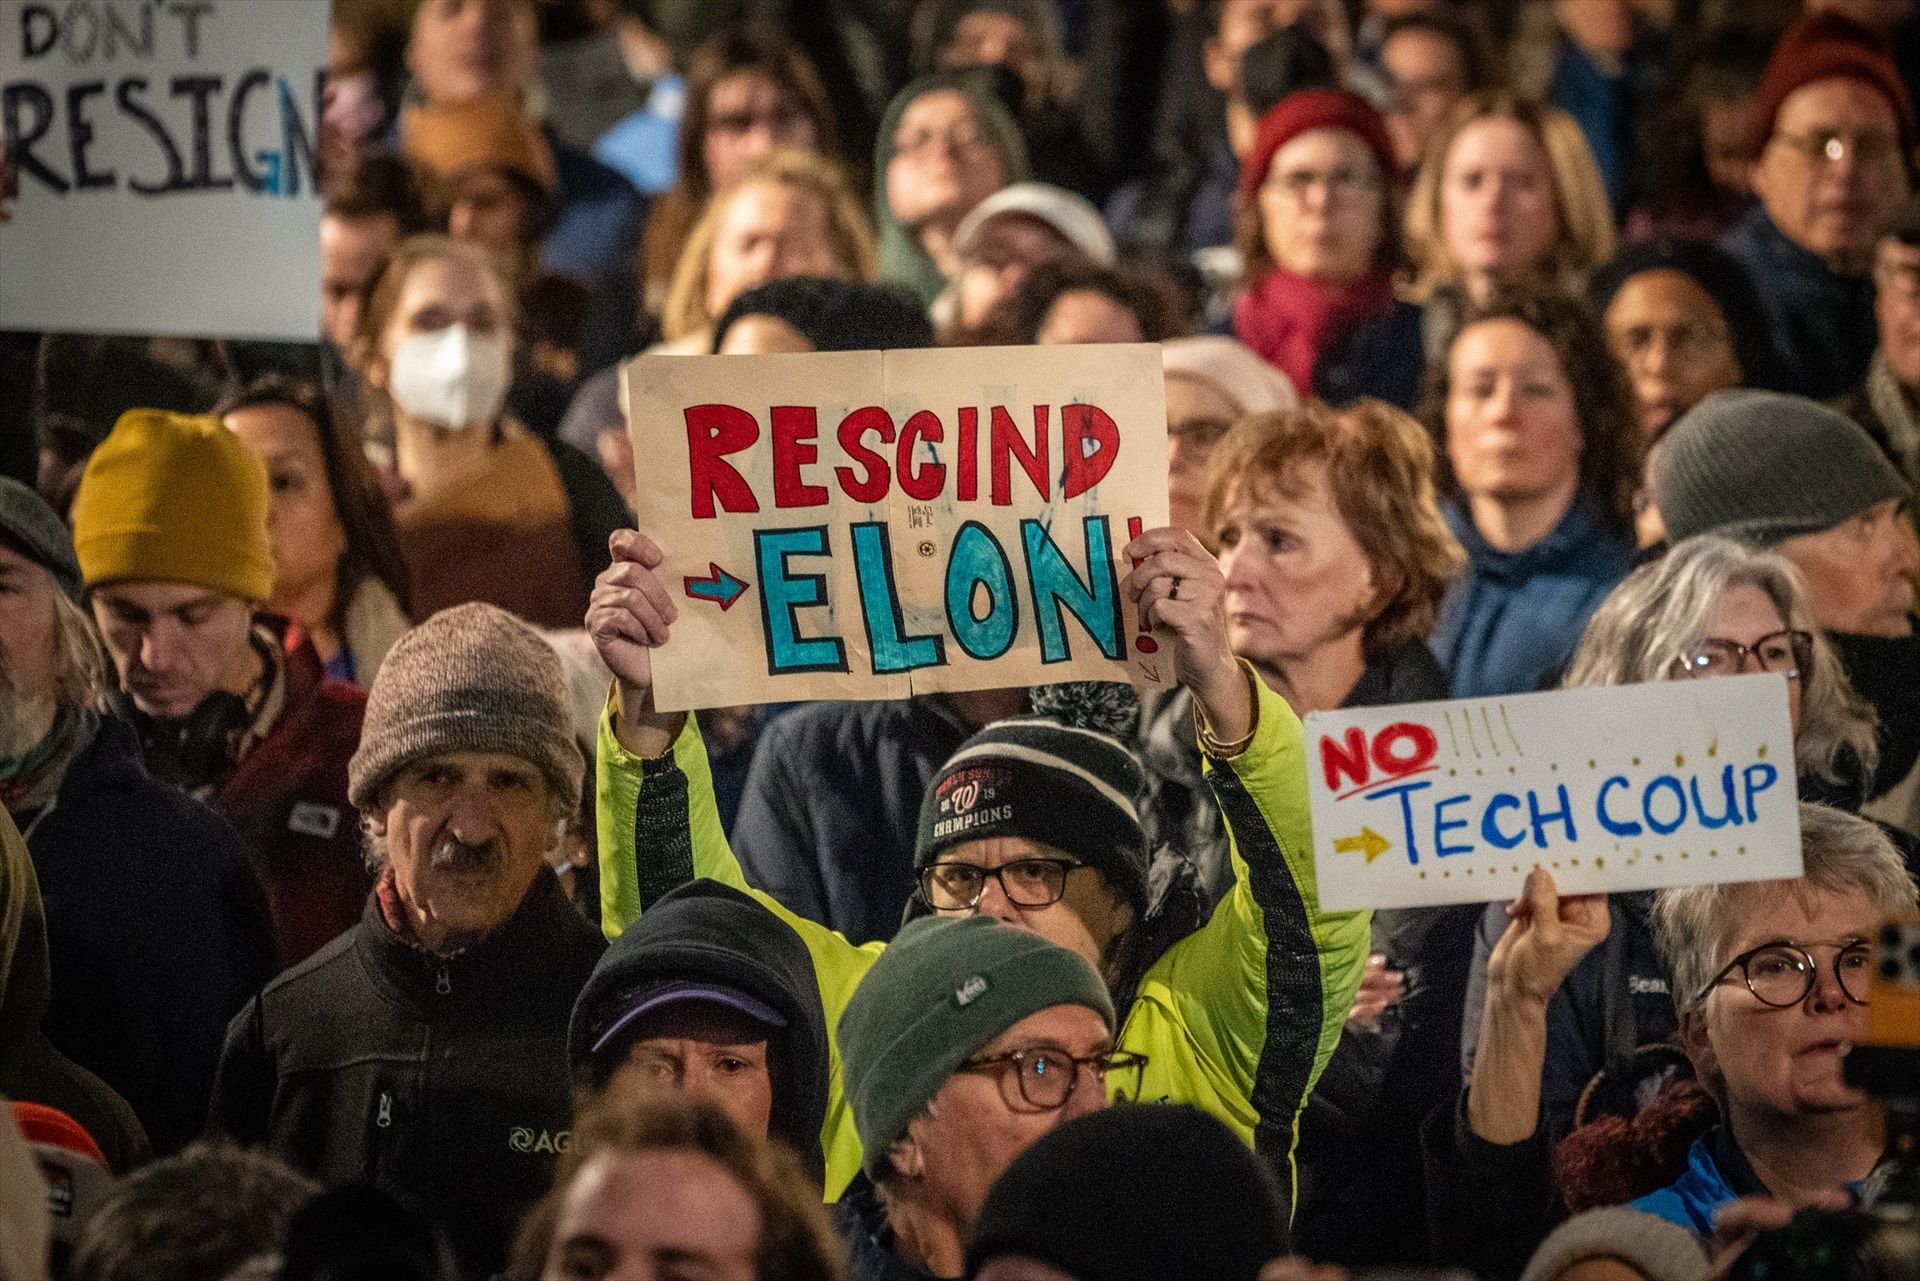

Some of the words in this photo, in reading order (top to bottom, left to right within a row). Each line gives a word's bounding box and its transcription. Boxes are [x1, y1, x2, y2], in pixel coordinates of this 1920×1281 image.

[1, 66, 326, 198] RESIGN
[684, 403, 1121, 519] RESCIND
[933, 805, 1012, 837] CHAMPIONS
[1364, 781, 1578, 865] TECH
[1596, 763, 1777, 836] COUP
